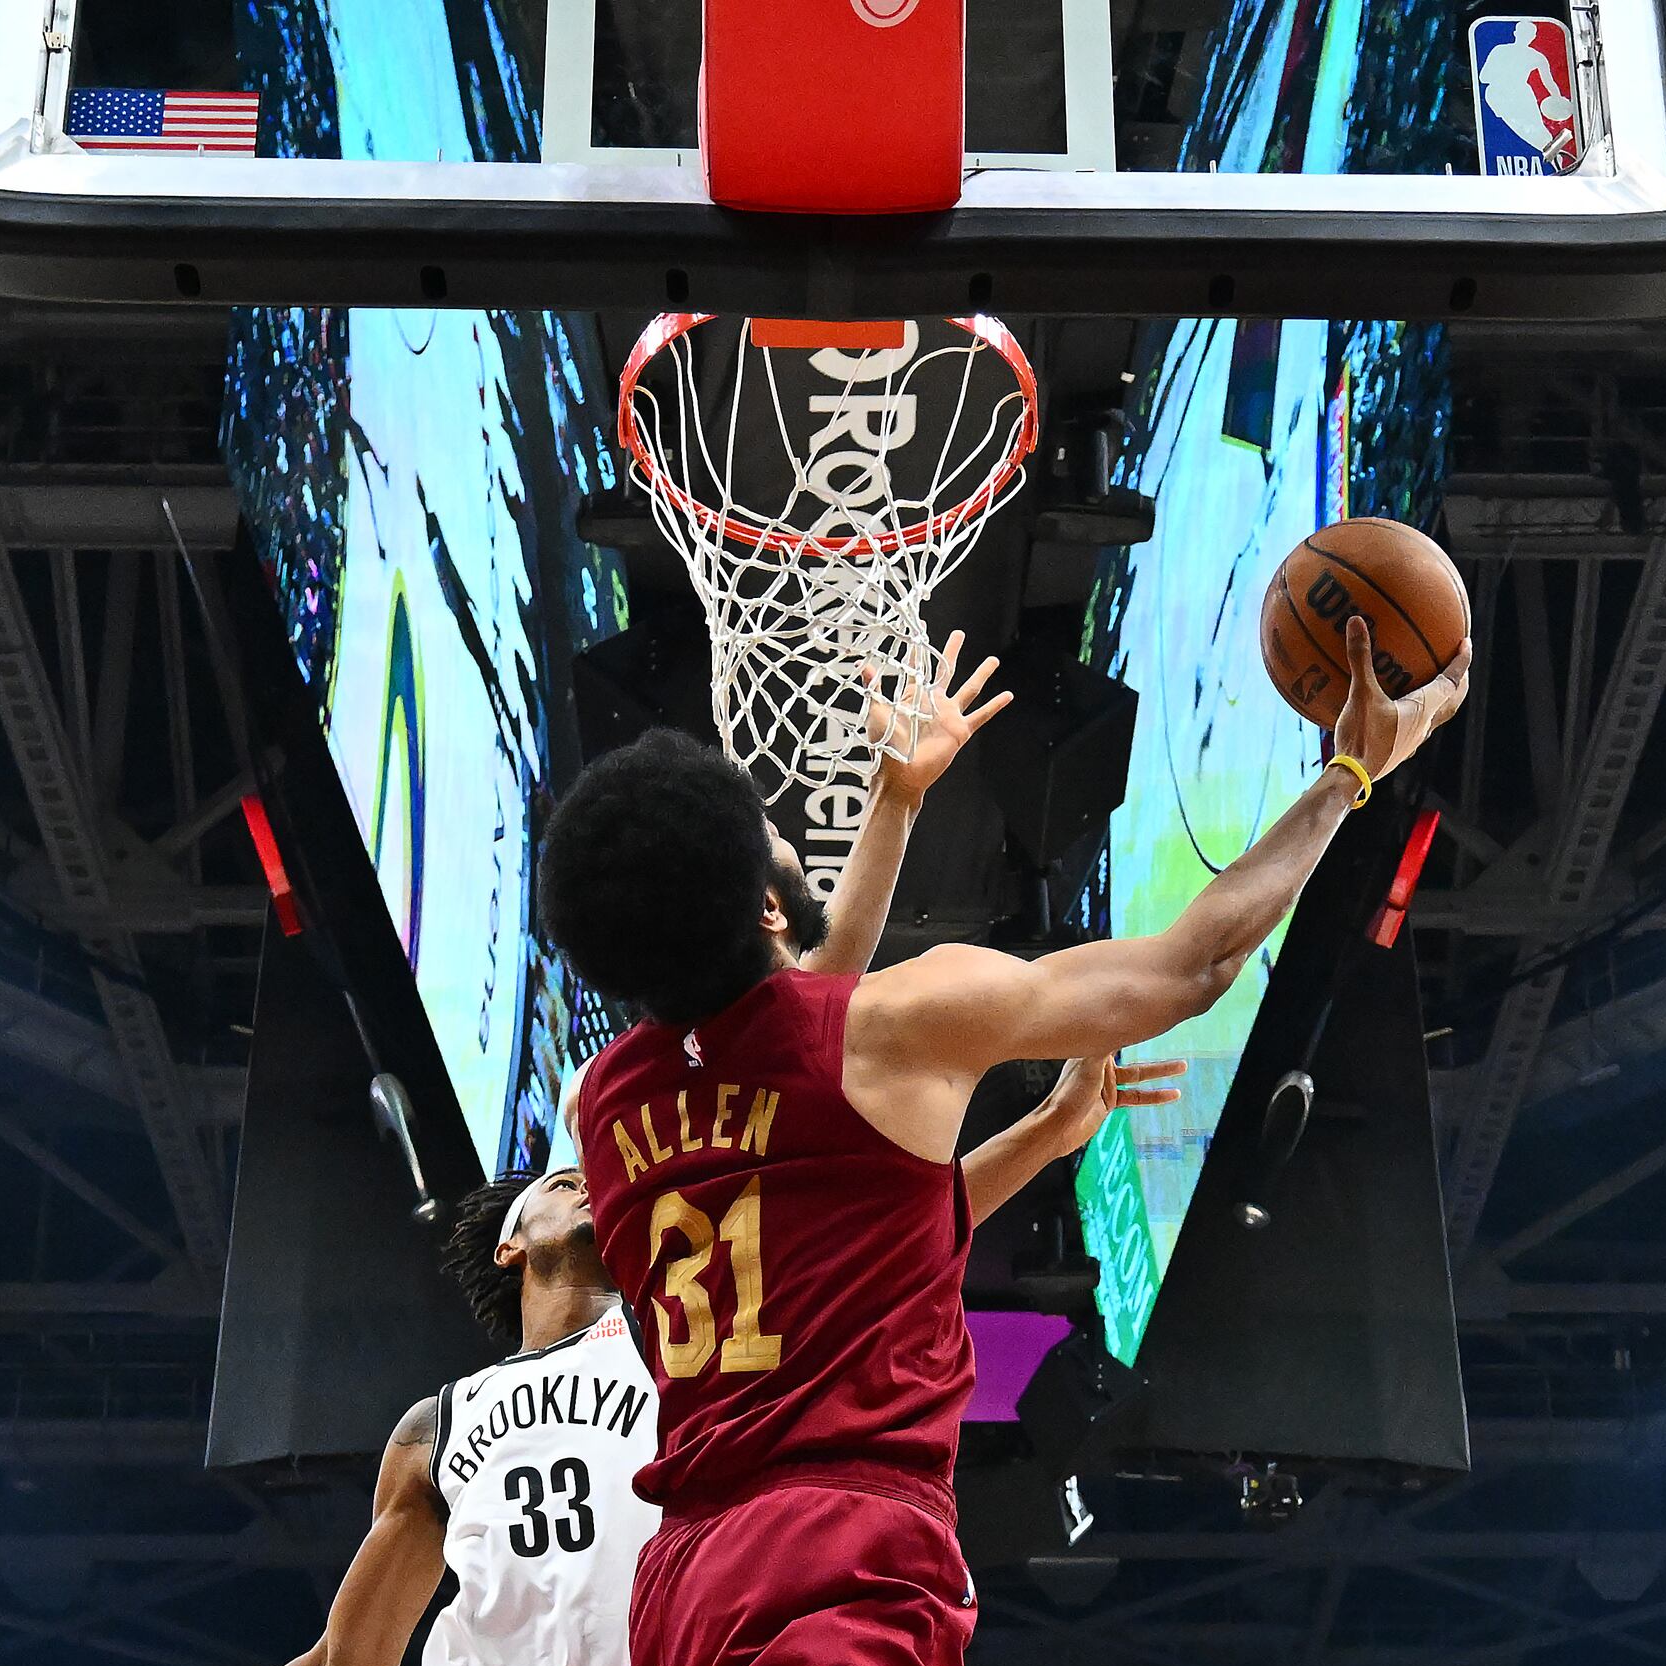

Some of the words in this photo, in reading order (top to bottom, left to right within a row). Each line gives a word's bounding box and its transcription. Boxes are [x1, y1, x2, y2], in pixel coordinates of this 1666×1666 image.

[1496, 156, 1544, 177] NBA
[611, 1084, 781, 1184] ALLEN
[649, 1175, 783, 1379] 31
[584, 1327, 627, 1342] UIDE
[448, 1374, 650, 1484] BROOKLYN
[503, 1457, 596, 1558] 33
